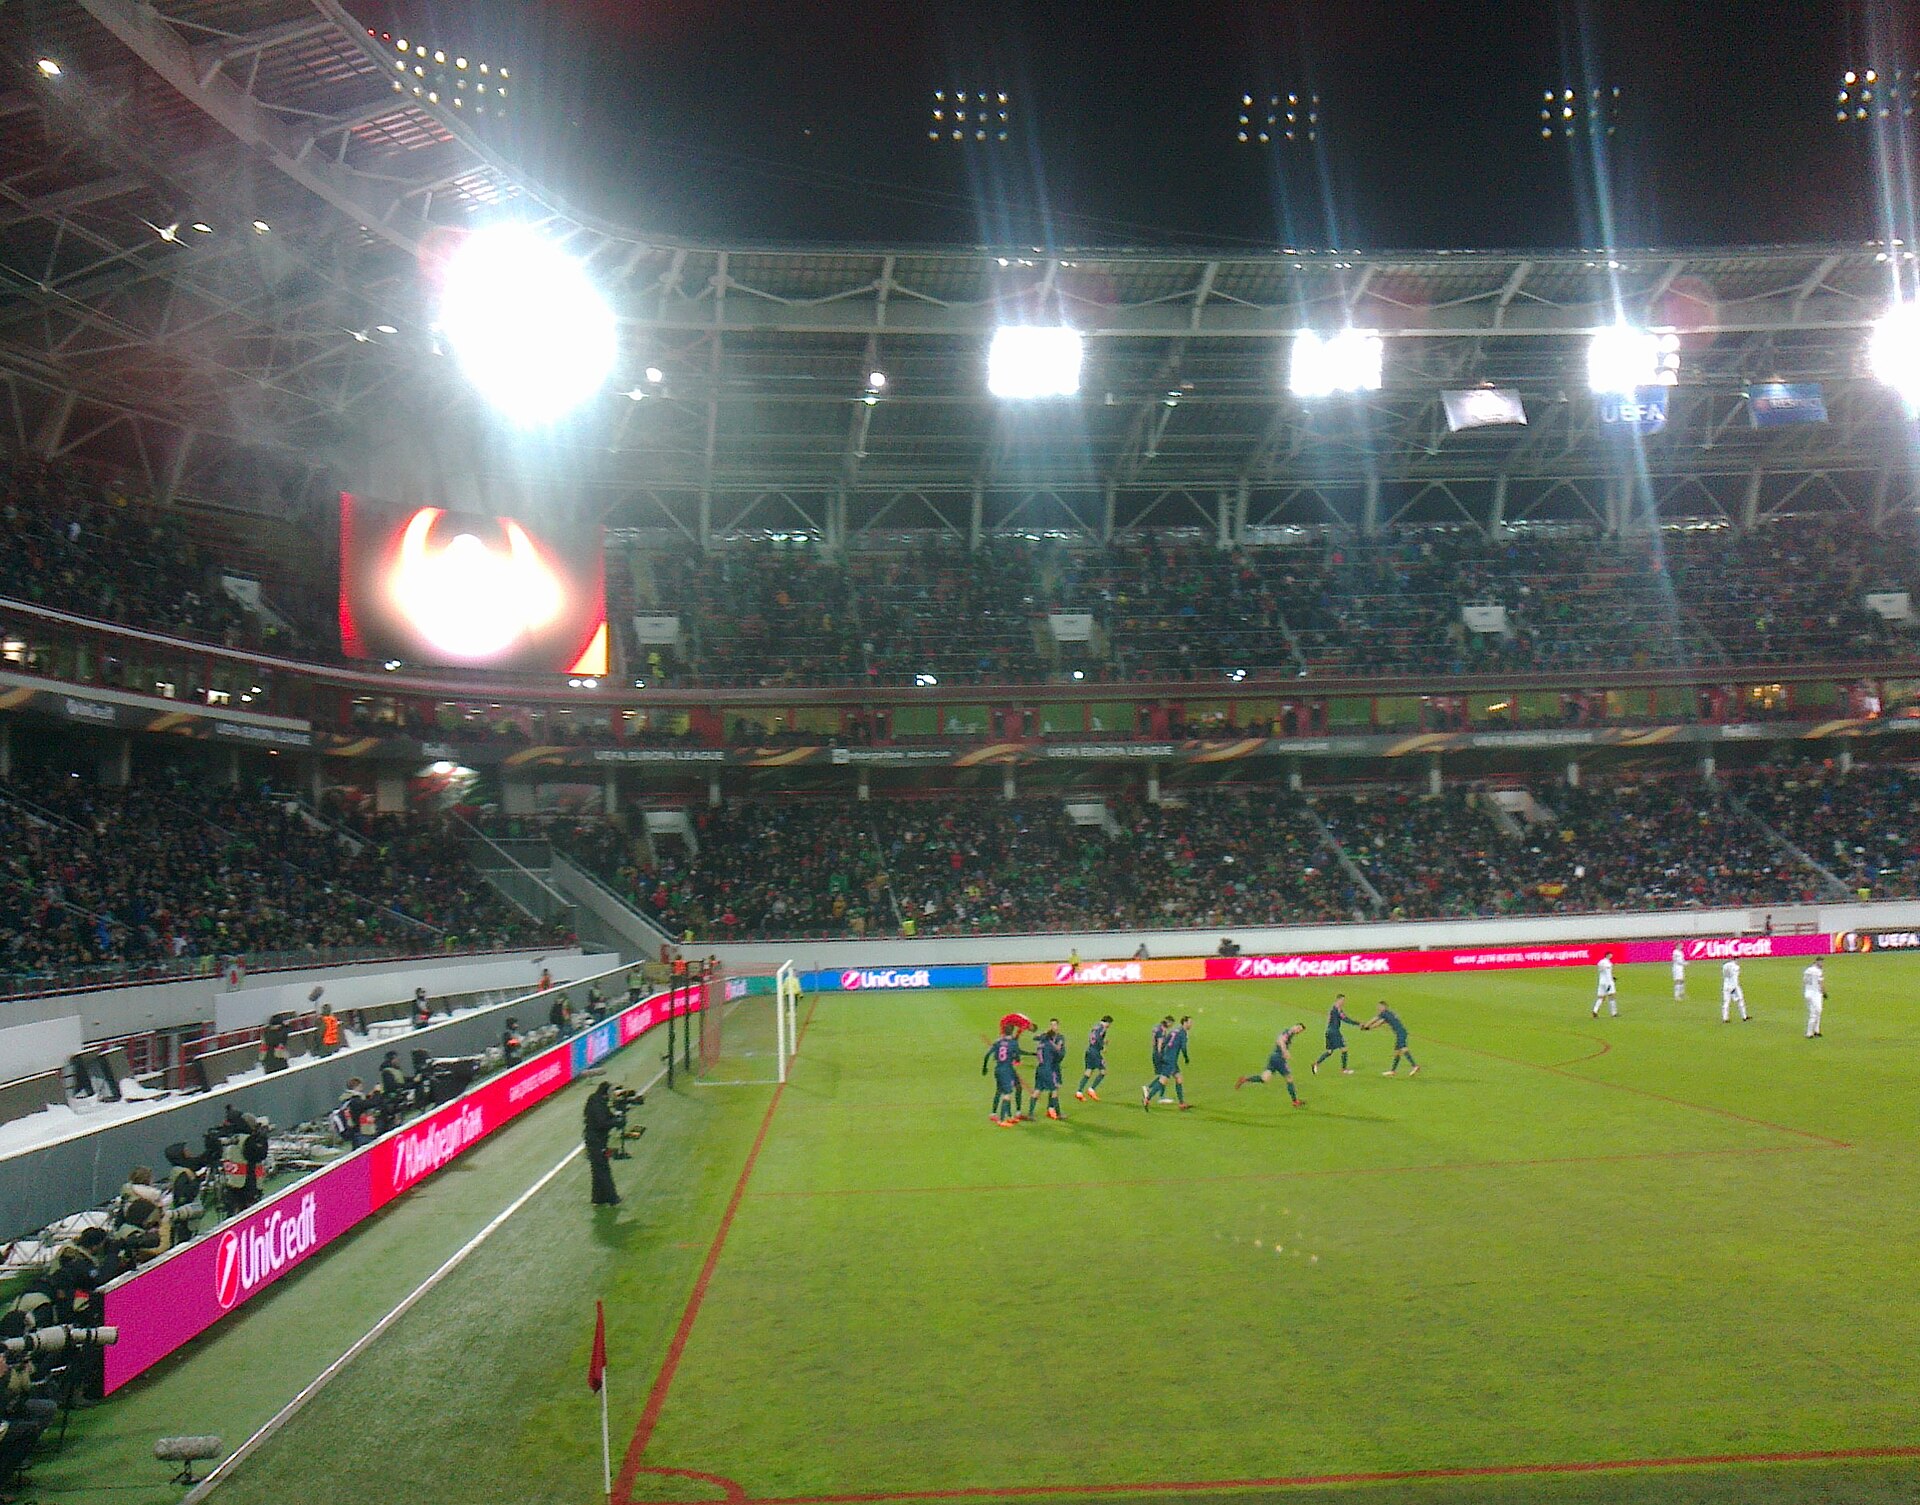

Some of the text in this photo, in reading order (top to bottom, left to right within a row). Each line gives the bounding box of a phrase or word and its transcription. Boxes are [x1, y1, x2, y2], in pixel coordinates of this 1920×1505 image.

[1602, 404, 1666, 422] UEFA
[1707, 938, 1772, 957] UniCredit
[1878, 933, 1919, 948] UEFA
[861, 969, 930, 988] UniCredit
[998, 1046, 1008, 1062] 8
[241, 1191, 317, 1290] UniCredit
